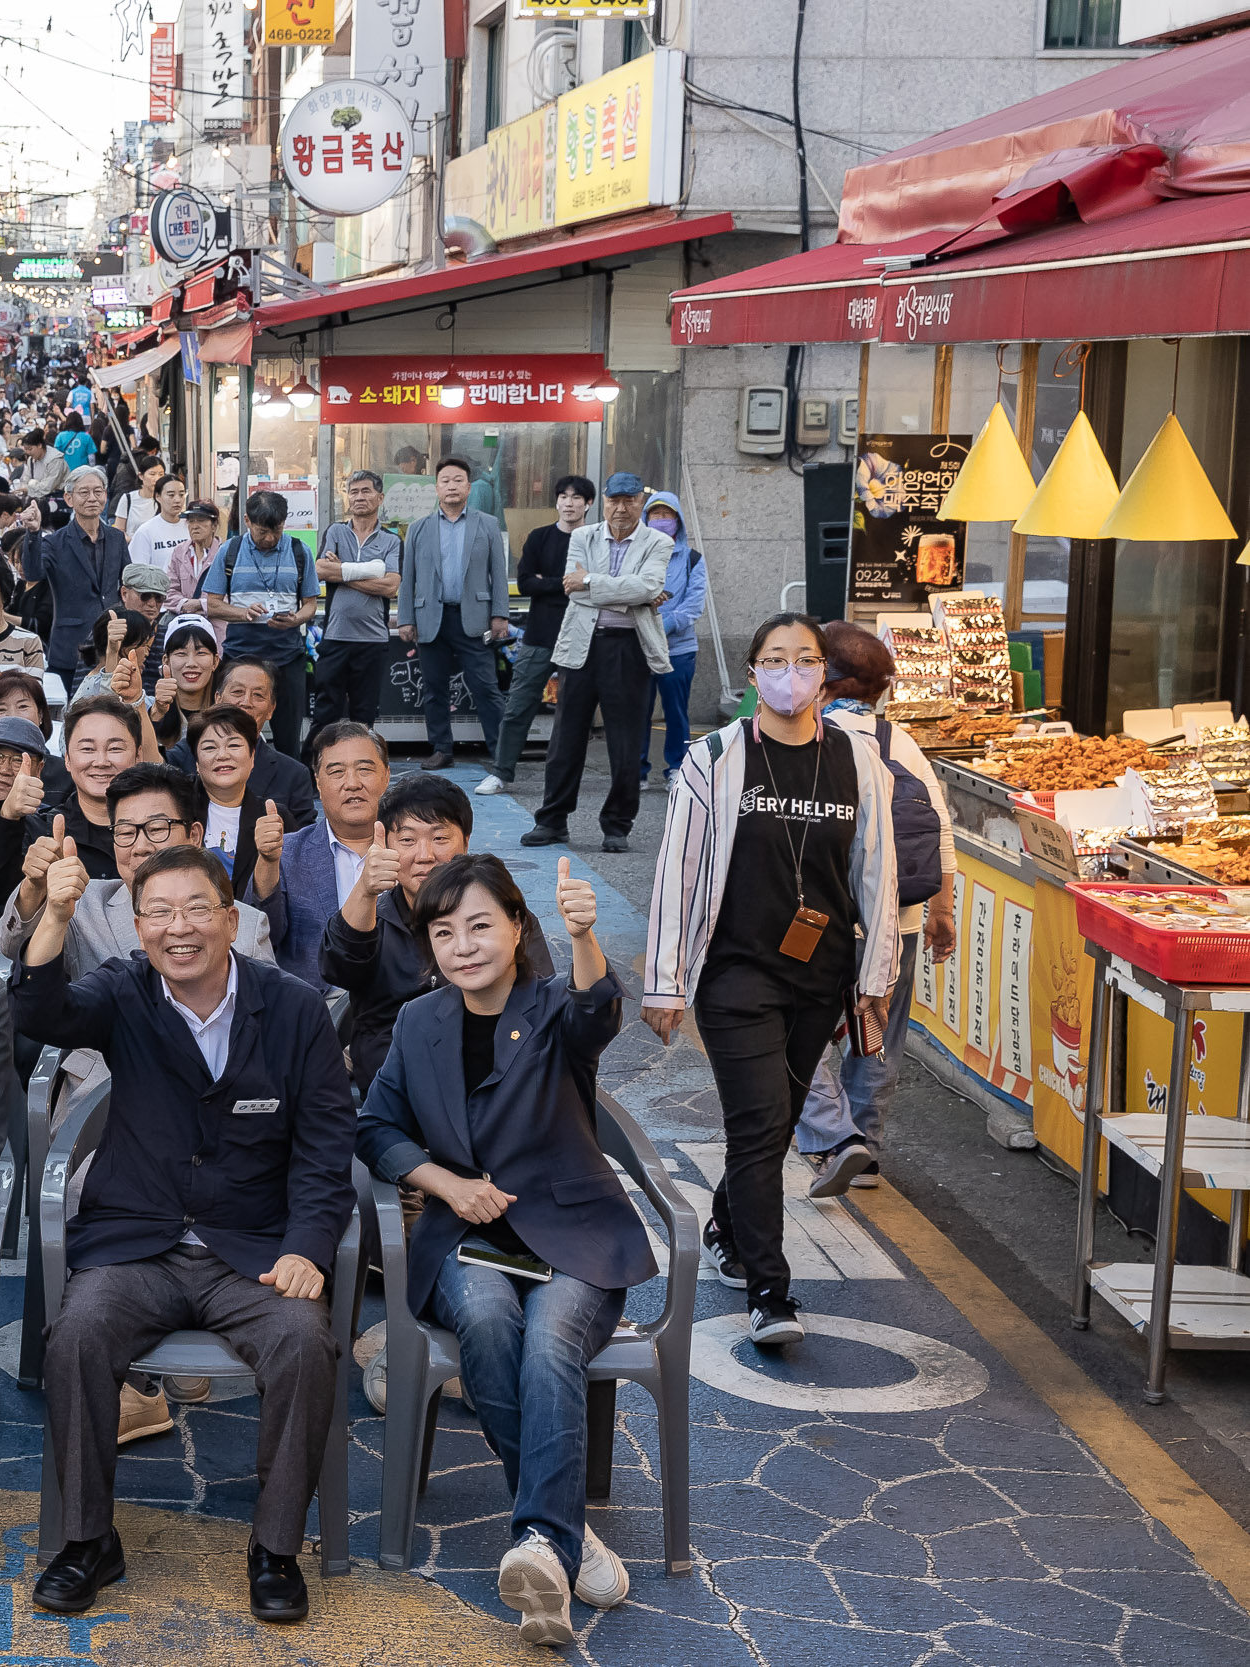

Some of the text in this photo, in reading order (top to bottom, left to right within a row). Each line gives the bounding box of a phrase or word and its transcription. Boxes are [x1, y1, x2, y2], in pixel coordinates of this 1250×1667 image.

[268, 28, 331, 41] 466-0222
[566, 84, 641, 181] 황금축산
[293, 132, 404, 177] 황금축산
[469, 383, 565, 405] 판매합니다
[855, 570, 889, 581] 09.24
[756, 796, 788, 812] ERY
[791, 798, 855, 821] HELPER
